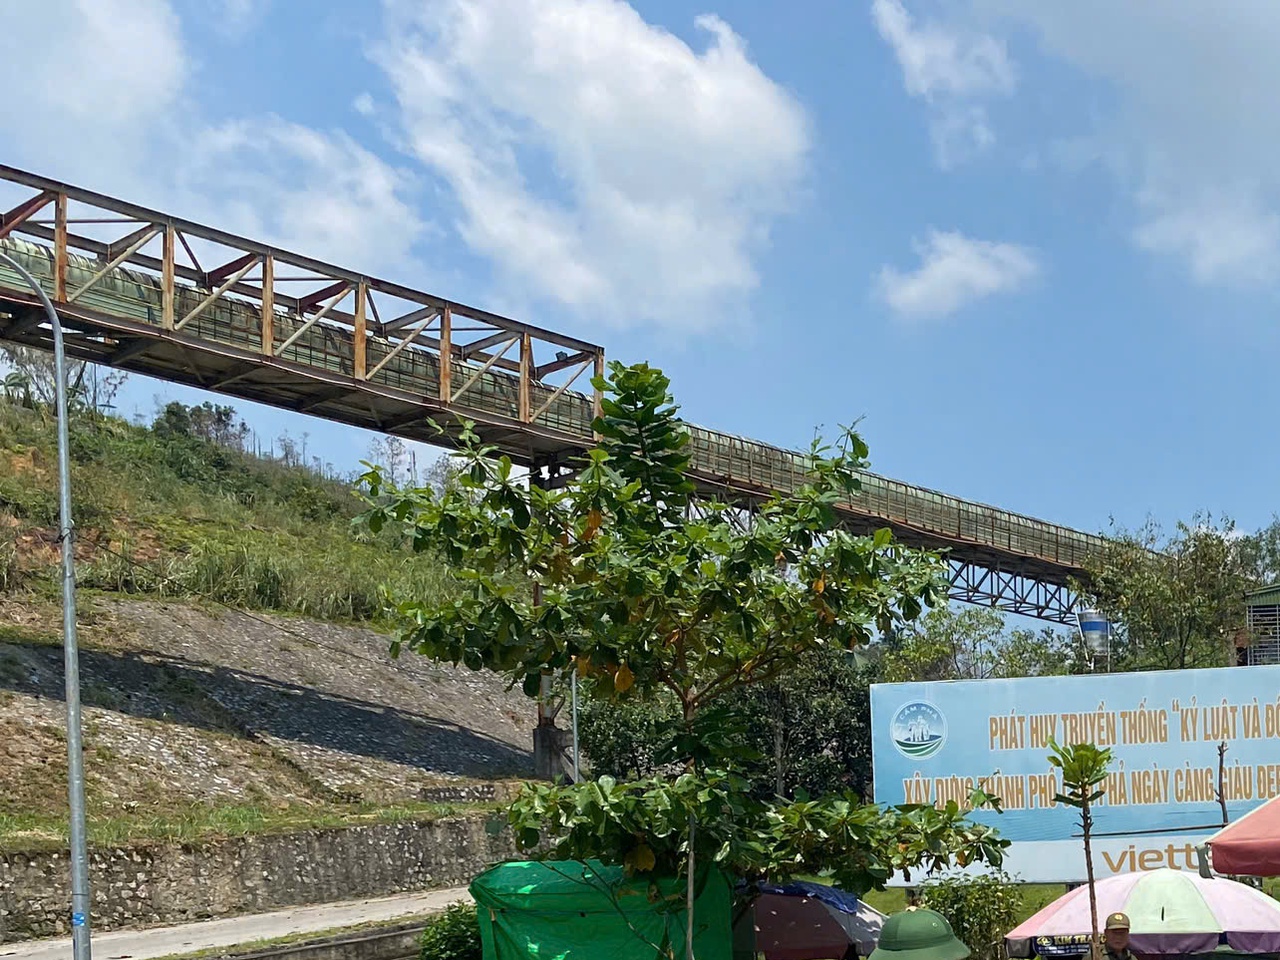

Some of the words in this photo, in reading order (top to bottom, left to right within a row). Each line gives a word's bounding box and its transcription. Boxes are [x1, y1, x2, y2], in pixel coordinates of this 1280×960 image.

[989, 708, 1026, 749] PHÁT
[1030, 714, 1057, 748] HUY
[1061, 701, 1116, 746] TRUYỀN
[1120, 698, 1168, 744] THỐNG
[1203, 699, 1238, 747] LUẬT
[1242, 698, 1261, 739] VÀ
[904, 772, 931, 806] XÂY
[977, 769, 1024, 809] THÀNH
[1131, 763, 1169, 805] NGÀY
[1174, 761, 1214, 803] CÀNG
[1220, 759, 1252, 801] GIÀU
[1101, 843, 1212, 874] viett
[1054, 935, 1073, 945] KIM
[1073, 934, 1107, 944] TRAG
